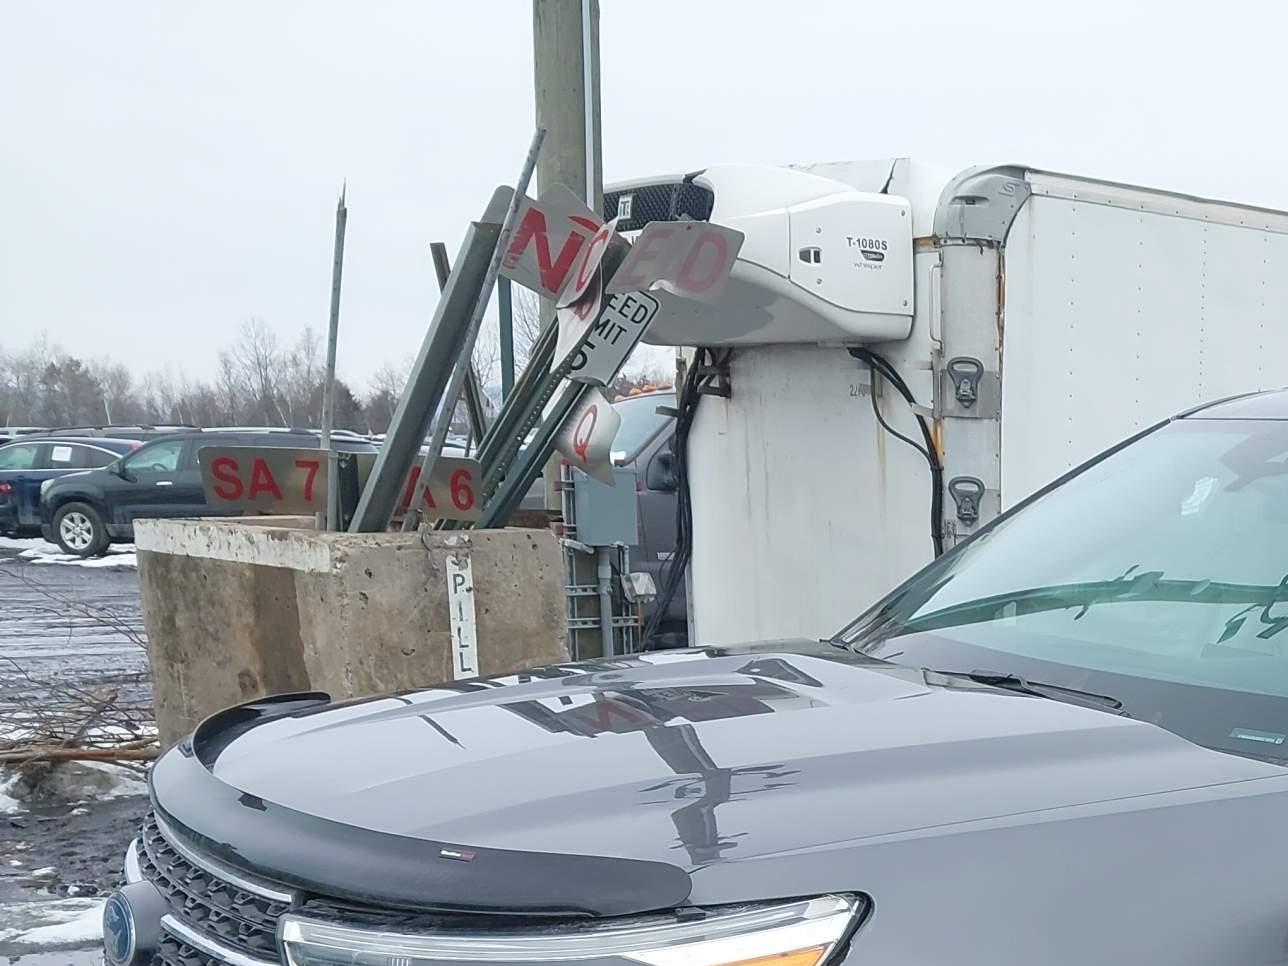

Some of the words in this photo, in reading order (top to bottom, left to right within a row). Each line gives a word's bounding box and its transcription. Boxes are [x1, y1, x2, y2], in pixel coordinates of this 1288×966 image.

[846, 236, 889, 251] T-1080S
[606, 294, 649, 325] EED
[594, 317, 628, 346] MIT
[211, 456, 284, 501] SA
[295, 459, 320, 501] 7
[449, 468, 475, 512] 6
